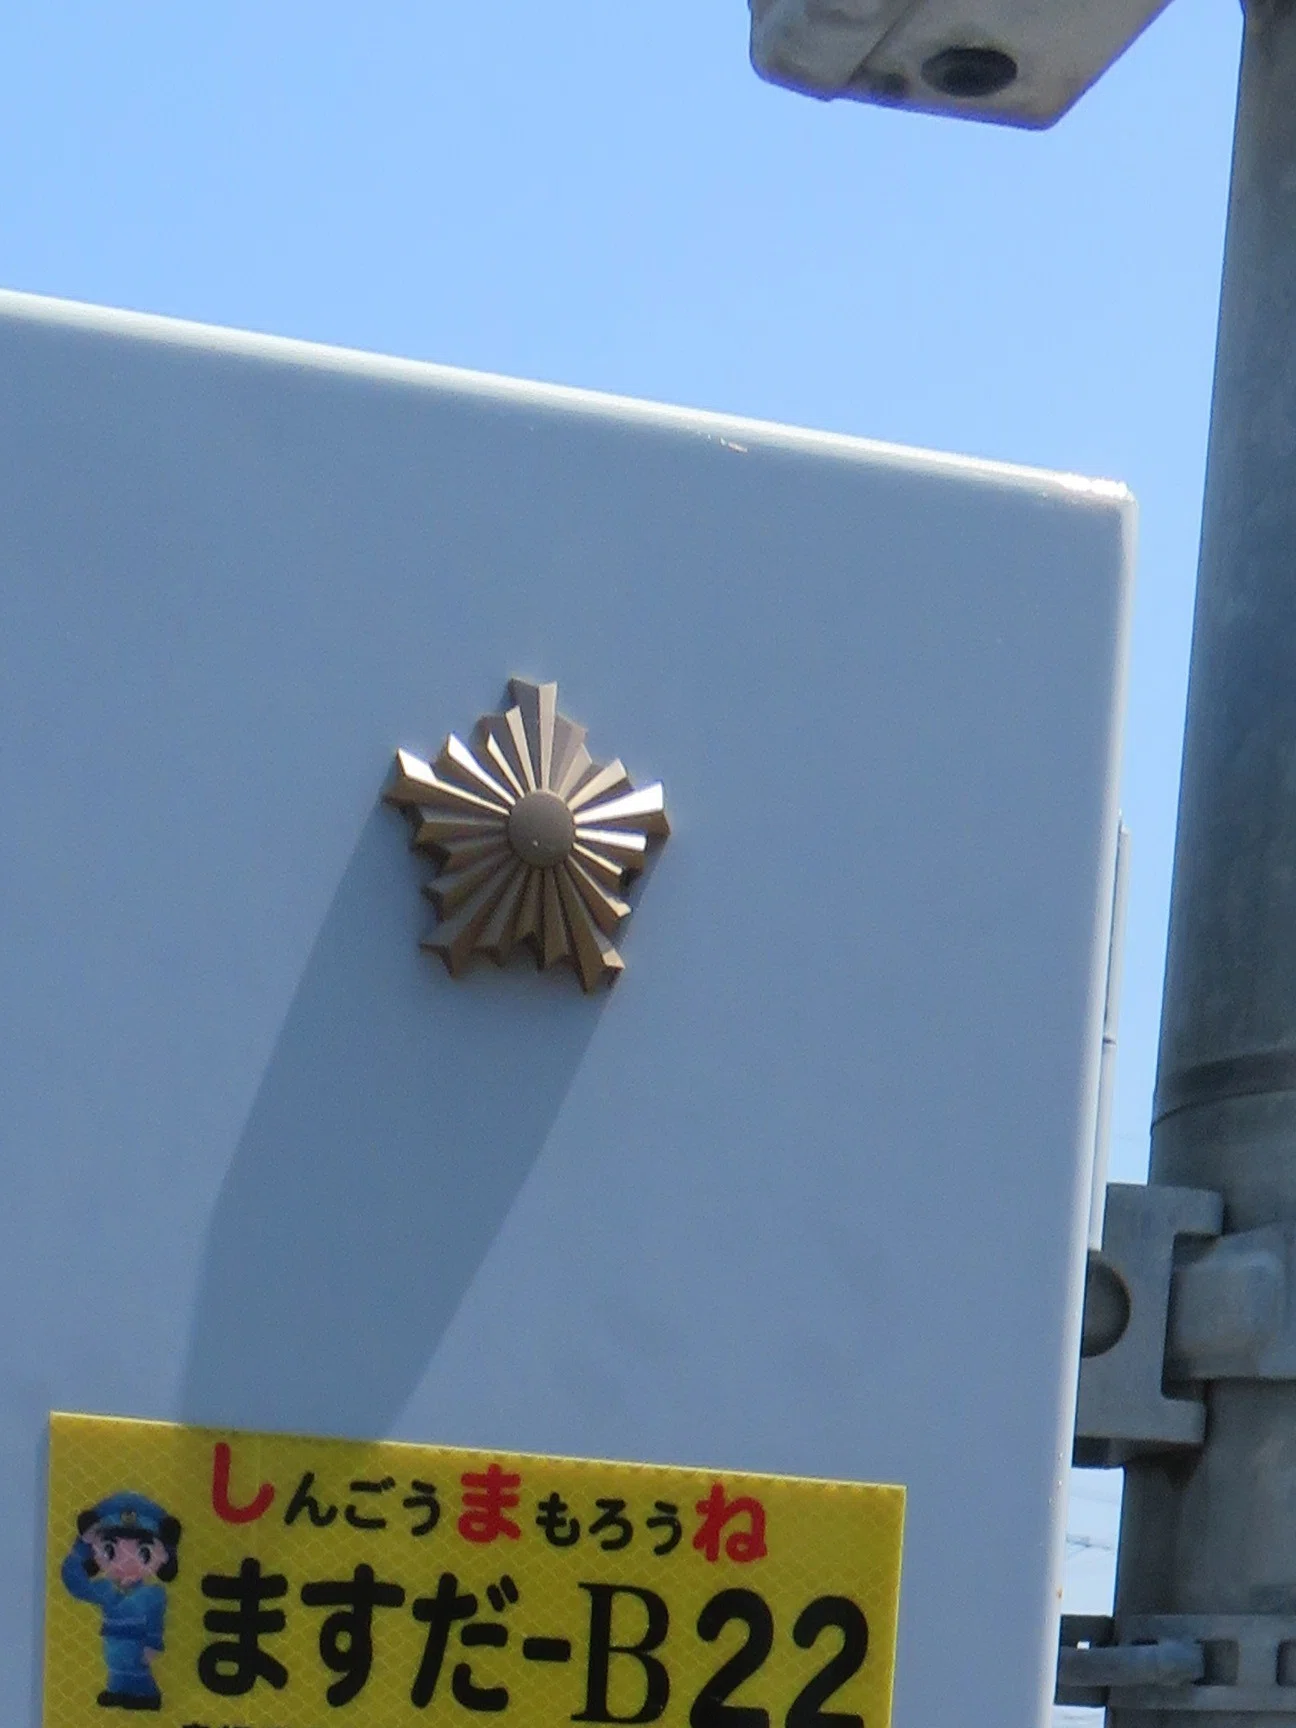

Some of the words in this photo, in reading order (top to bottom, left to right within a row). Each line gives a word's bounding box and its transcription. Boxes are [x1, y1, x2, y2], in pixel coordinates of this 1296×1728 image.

[211, 1442, 768, 1564] しんごうまもろうね
